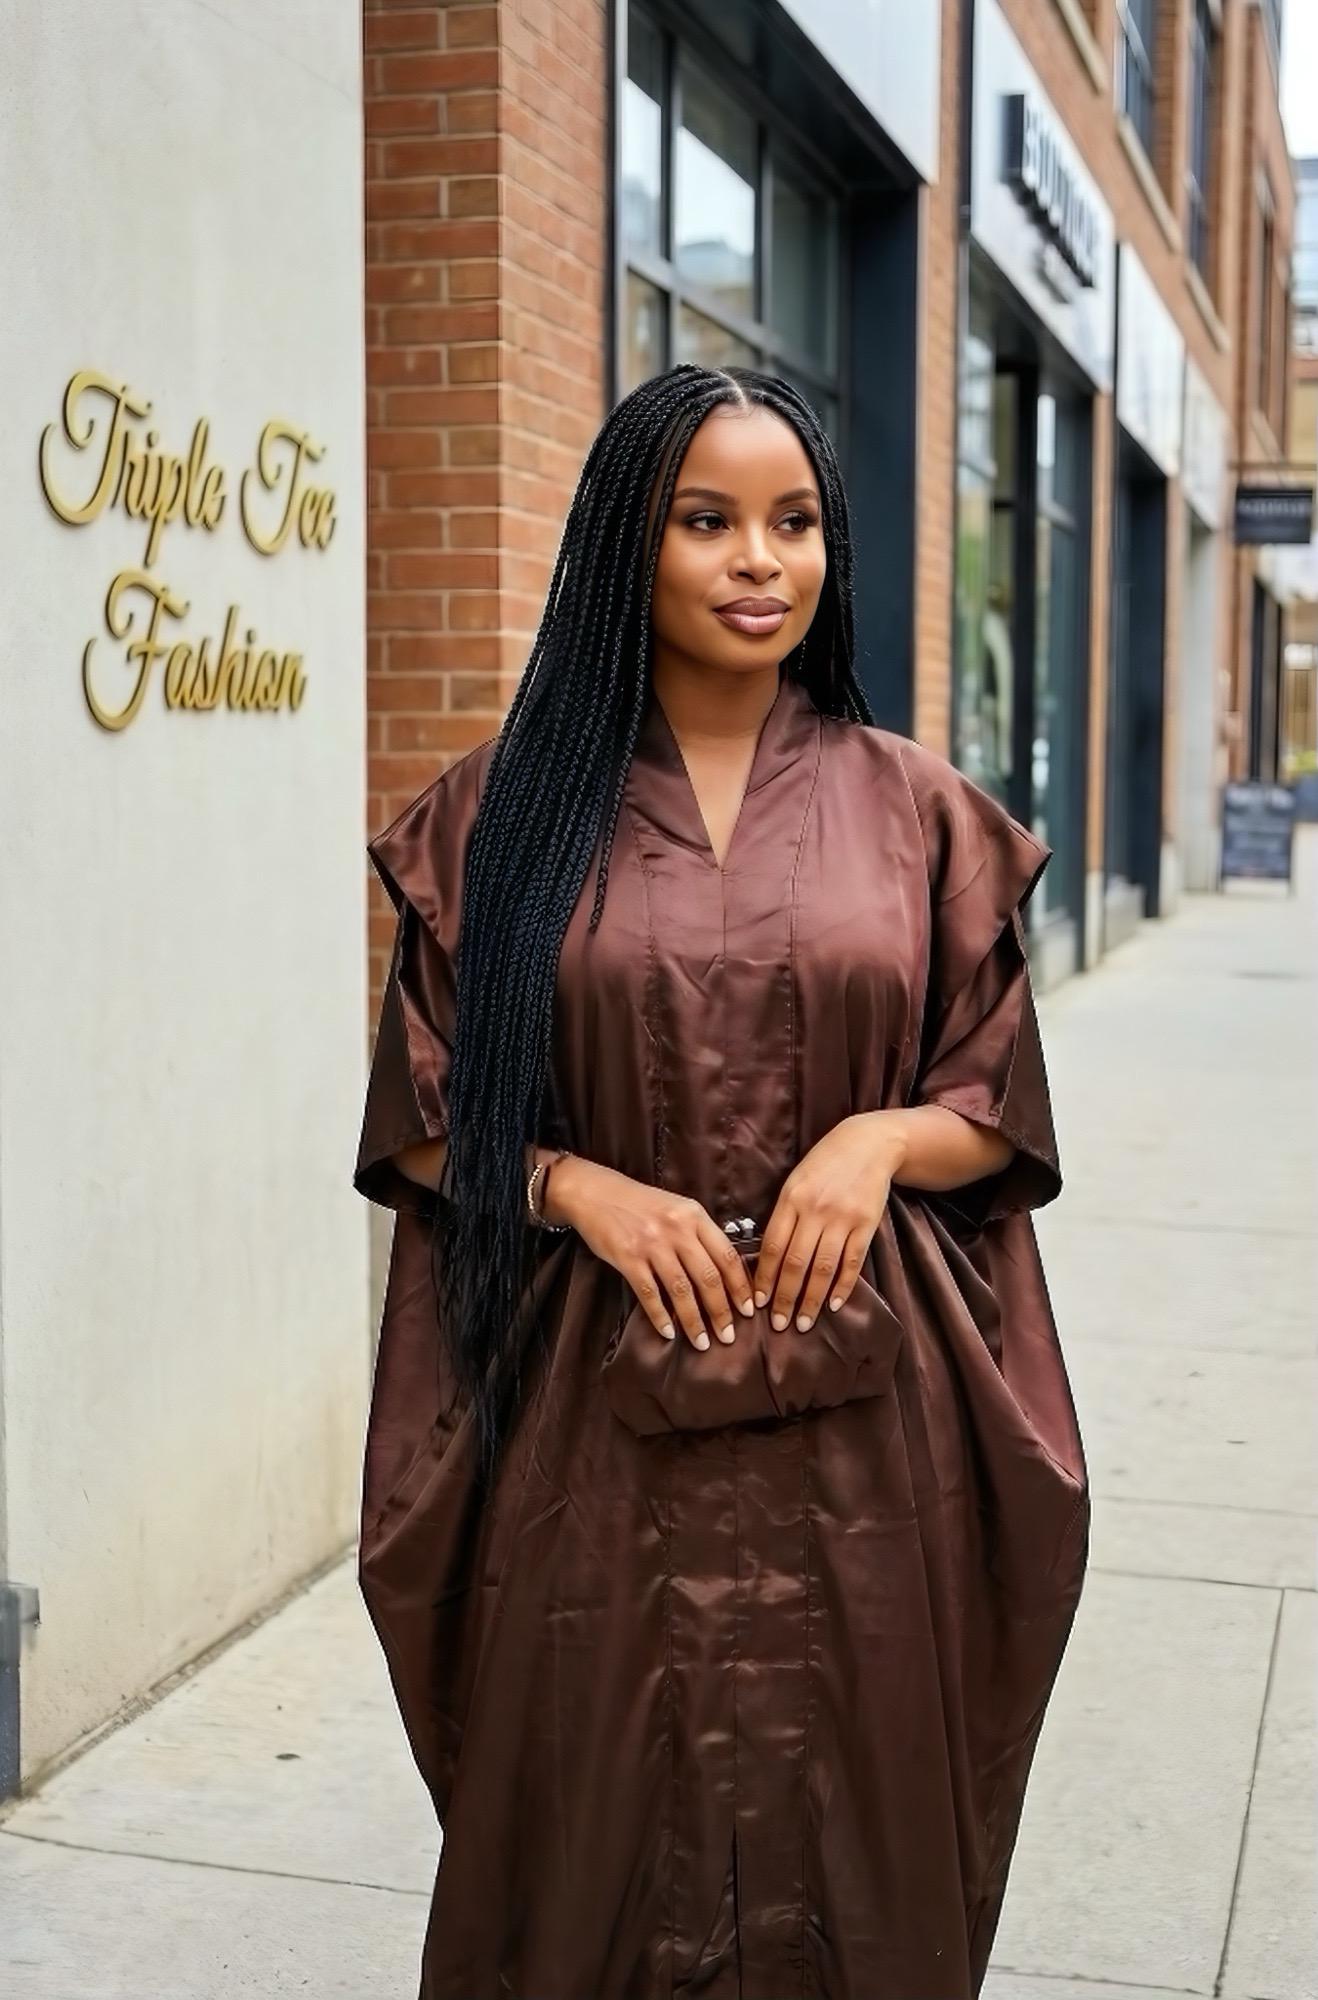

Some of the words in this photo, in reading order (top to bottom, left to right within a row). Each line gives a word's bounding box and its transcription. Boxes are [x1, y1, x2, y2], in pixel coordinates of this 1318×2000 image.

[39, 371, 227, 567] Triple
[240, 420, 337, 556] Tee
[82, 569, 308, 732] Fashion
